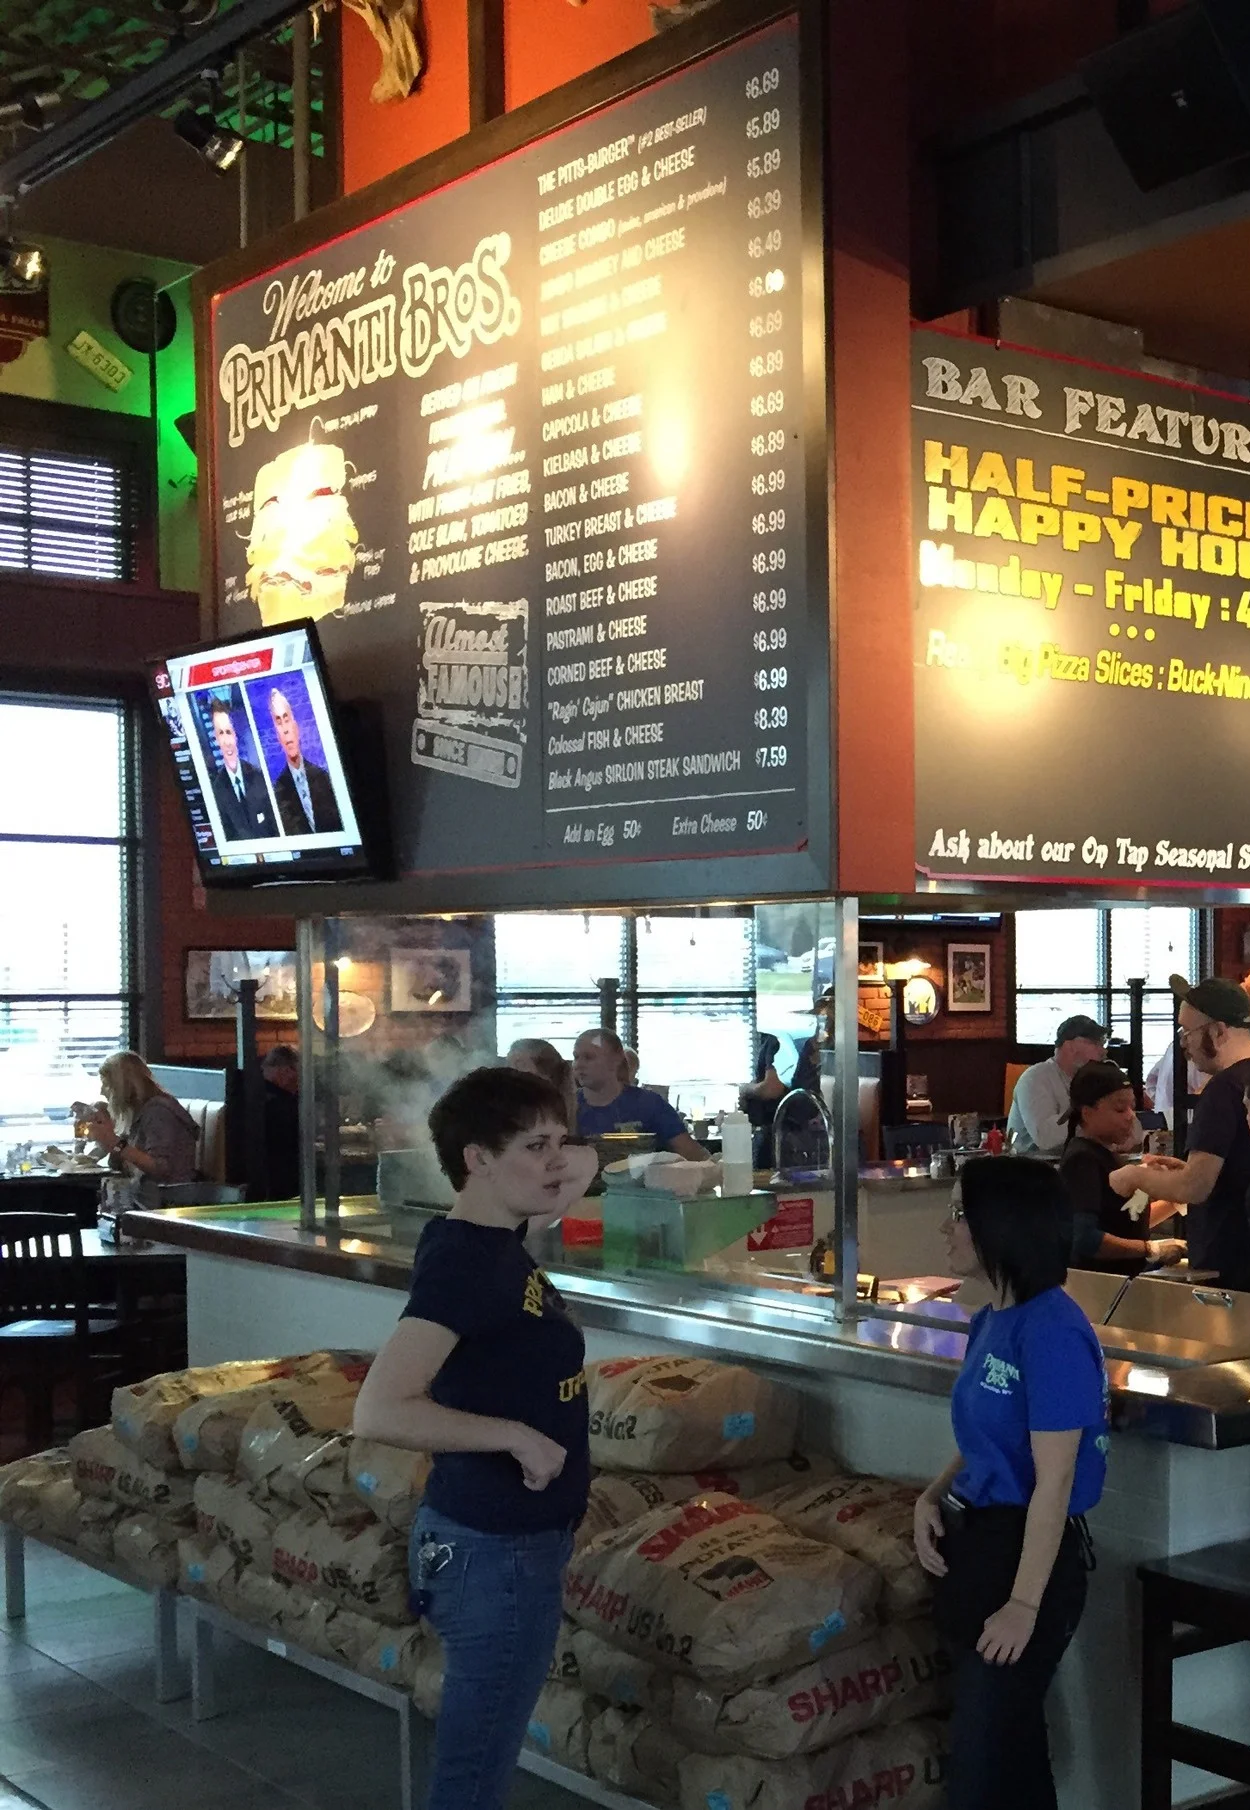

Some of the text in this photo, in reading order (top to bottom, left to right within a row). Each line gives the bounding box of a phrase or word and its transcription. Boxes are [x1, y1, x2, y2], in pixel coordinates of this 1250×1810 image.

[745, 68, 779, 99] $6.69
[746, 108, 780, 139] $5.89
[747, 148, 781, 179] $5.89
[537, 165, 557, 196] THE
[538, 145, 695, 232] DELUXE DOUBLE EGG & CHEESE
[748, 189, 782, 219] $6.39
[748, 229, 782, 259] $6.49
[263, 249, 397, 341] Welcome to
[219, 294, 396, 448] PRIMANTI
[400, 231, 521, 378] BROS.
[749, 310, 783, 338] $6.69
[750, 349, 784, 377] $6.89
[565, 379, 576, 400] &
[751, 390, 784, 417] $6.69
[922, 356, 1043, 420] BAR
[542, 408, 589, 442] CAPICOLA
[591, 407, 601, 428] &
[751, 430, 785, 457] $6.89
[543, 447, 588, 478] KIELBASA
[591, 443, 601, 464] &
[544, 472, 630, 513] BACON & CHEESE
[751, 469, 785, 496] $6.99
[544, 520, 582, 548] TURKEY
[584, 511, 622, 539] BREAST
[624, 507, 634, 528] &
[752, 509, 786, 535] $6.99
[928, 486, 1143, 560] HAPPY
[408, 528, 436, 555] COLE
[409, 561, 420, 585] &
[545, 538, 658, 583] BACON, EGG & CHEESE
[752, 548, 786, 575] $6.99
[546, 575, 657, 617] ROAST BEEF & CHEESE
[918, 539, 1063, 610] Monday
[1105, 569, 1211, 629] Friday
[753, 588, 787, 613] $6.99
[424, 615, 509, 654] Almost
[546, 614, 647, 652] PASTRAMI & CHEESE
[753, 627, 787, 653] $6.99
[547, 648, 667, 687] CORNED BEEF & CHEESE
[754, 666, 788, 691] $6.99
[1037, 643, 1090, 682] Pizza
[1095, 648, 1153, 690] Slices
[428, 666, 509, 707] FAMOUS
[617, 685, 661, 712] CHICKEN
[664, 679, 704, 705] BREAST
[754, 706, 788, 731] $8.39
[548, 722, 664, 756] Colossal FISH & CHEESE
[548, 750, 741, 792] Black Angus SIRLOIN STEAK SANDWICH
[755, 745, 788, 769] $7.59
[564, 824, 583, 844] Add
[584, 829, 595, 842] an
[597, 823, 615, 846] Egg
[672, 815, 698, 836] Extra
[700, 812, 737, 835] Cheese
[929, 828, 970, 864] Ask
[977, 830, 1035, 862] about
[1041, 840, 1075, 862] our
[1081, 836, 1109, 869] On
[1116, 837, 1149, 873] Tap
[1154, 838, 1233, 873] Seasonal
[787, 1661, 903, 1724] SHARP
